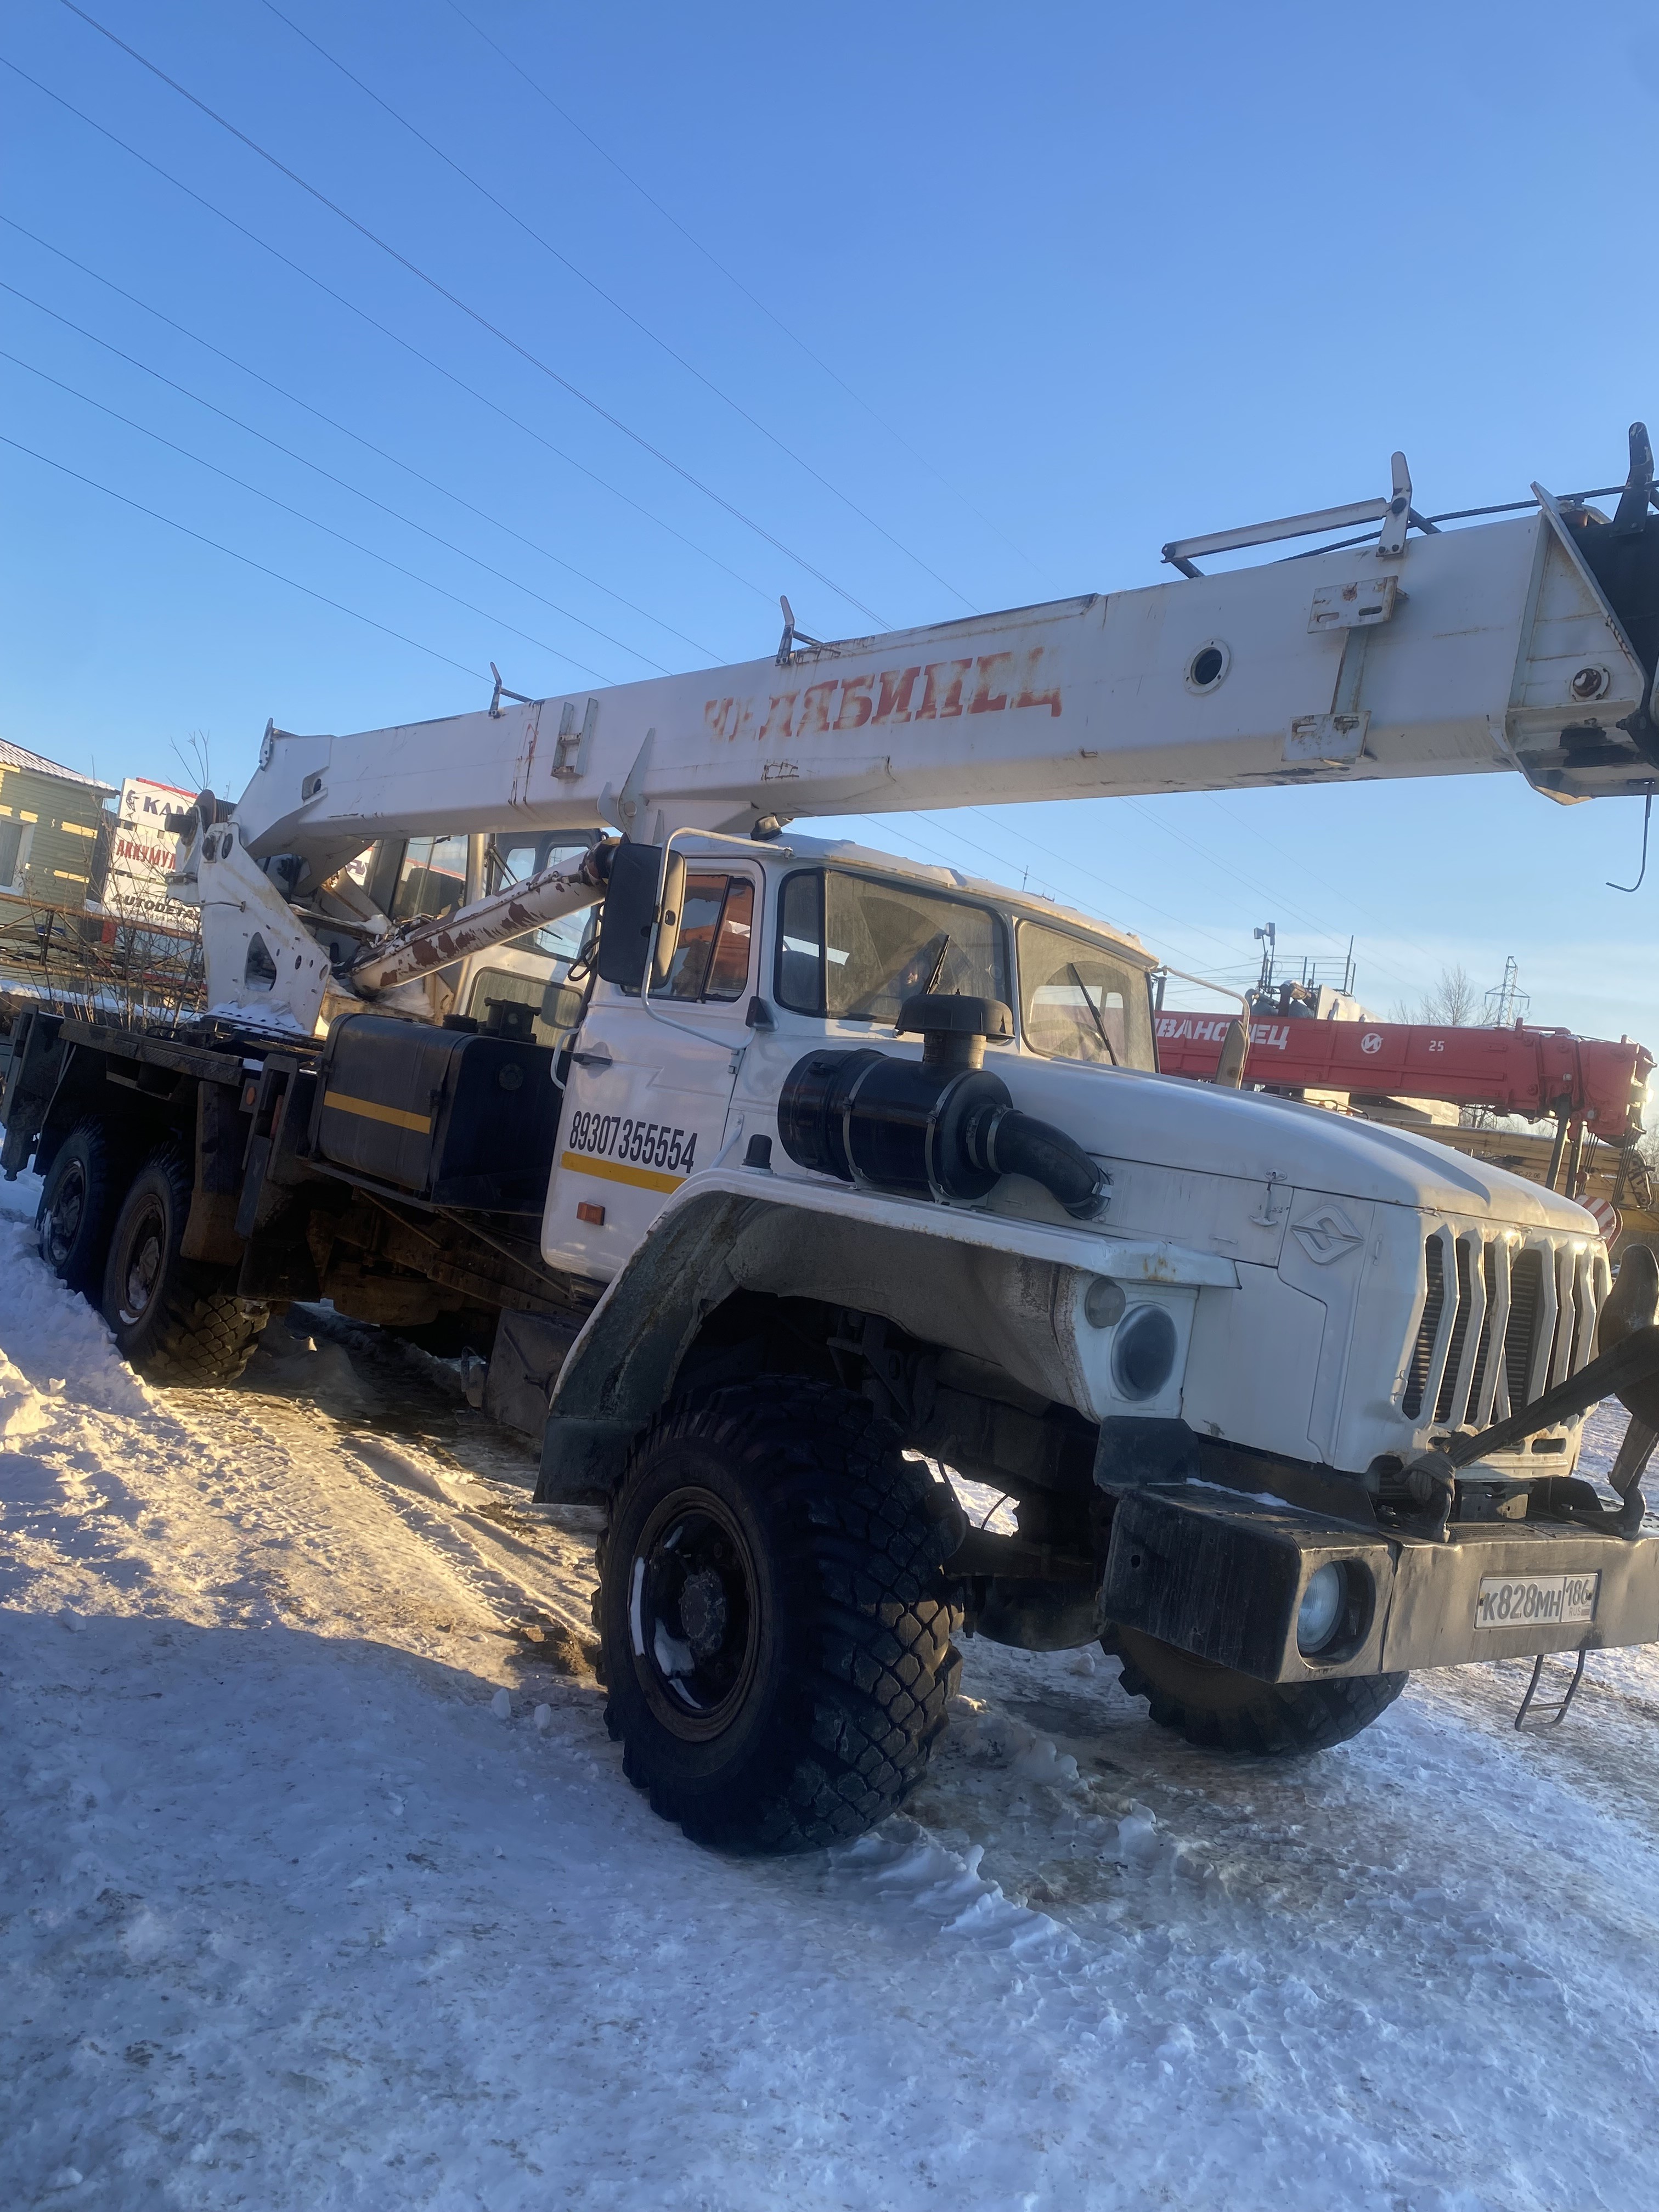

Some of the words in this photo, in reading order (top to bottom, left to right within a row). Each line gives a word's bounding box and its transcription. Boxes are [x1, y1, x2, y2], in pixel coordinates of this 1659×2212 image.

[1154, 1018, 1290, 1050] ВАНОЕЦ
[1429, 1040, 1445, 1052] 25
[569, 1110, 698, 1174] 89307355554
[1566, 1578, 1590, 1606] 186
[1568, 1607, 1582, 1616] RUS
